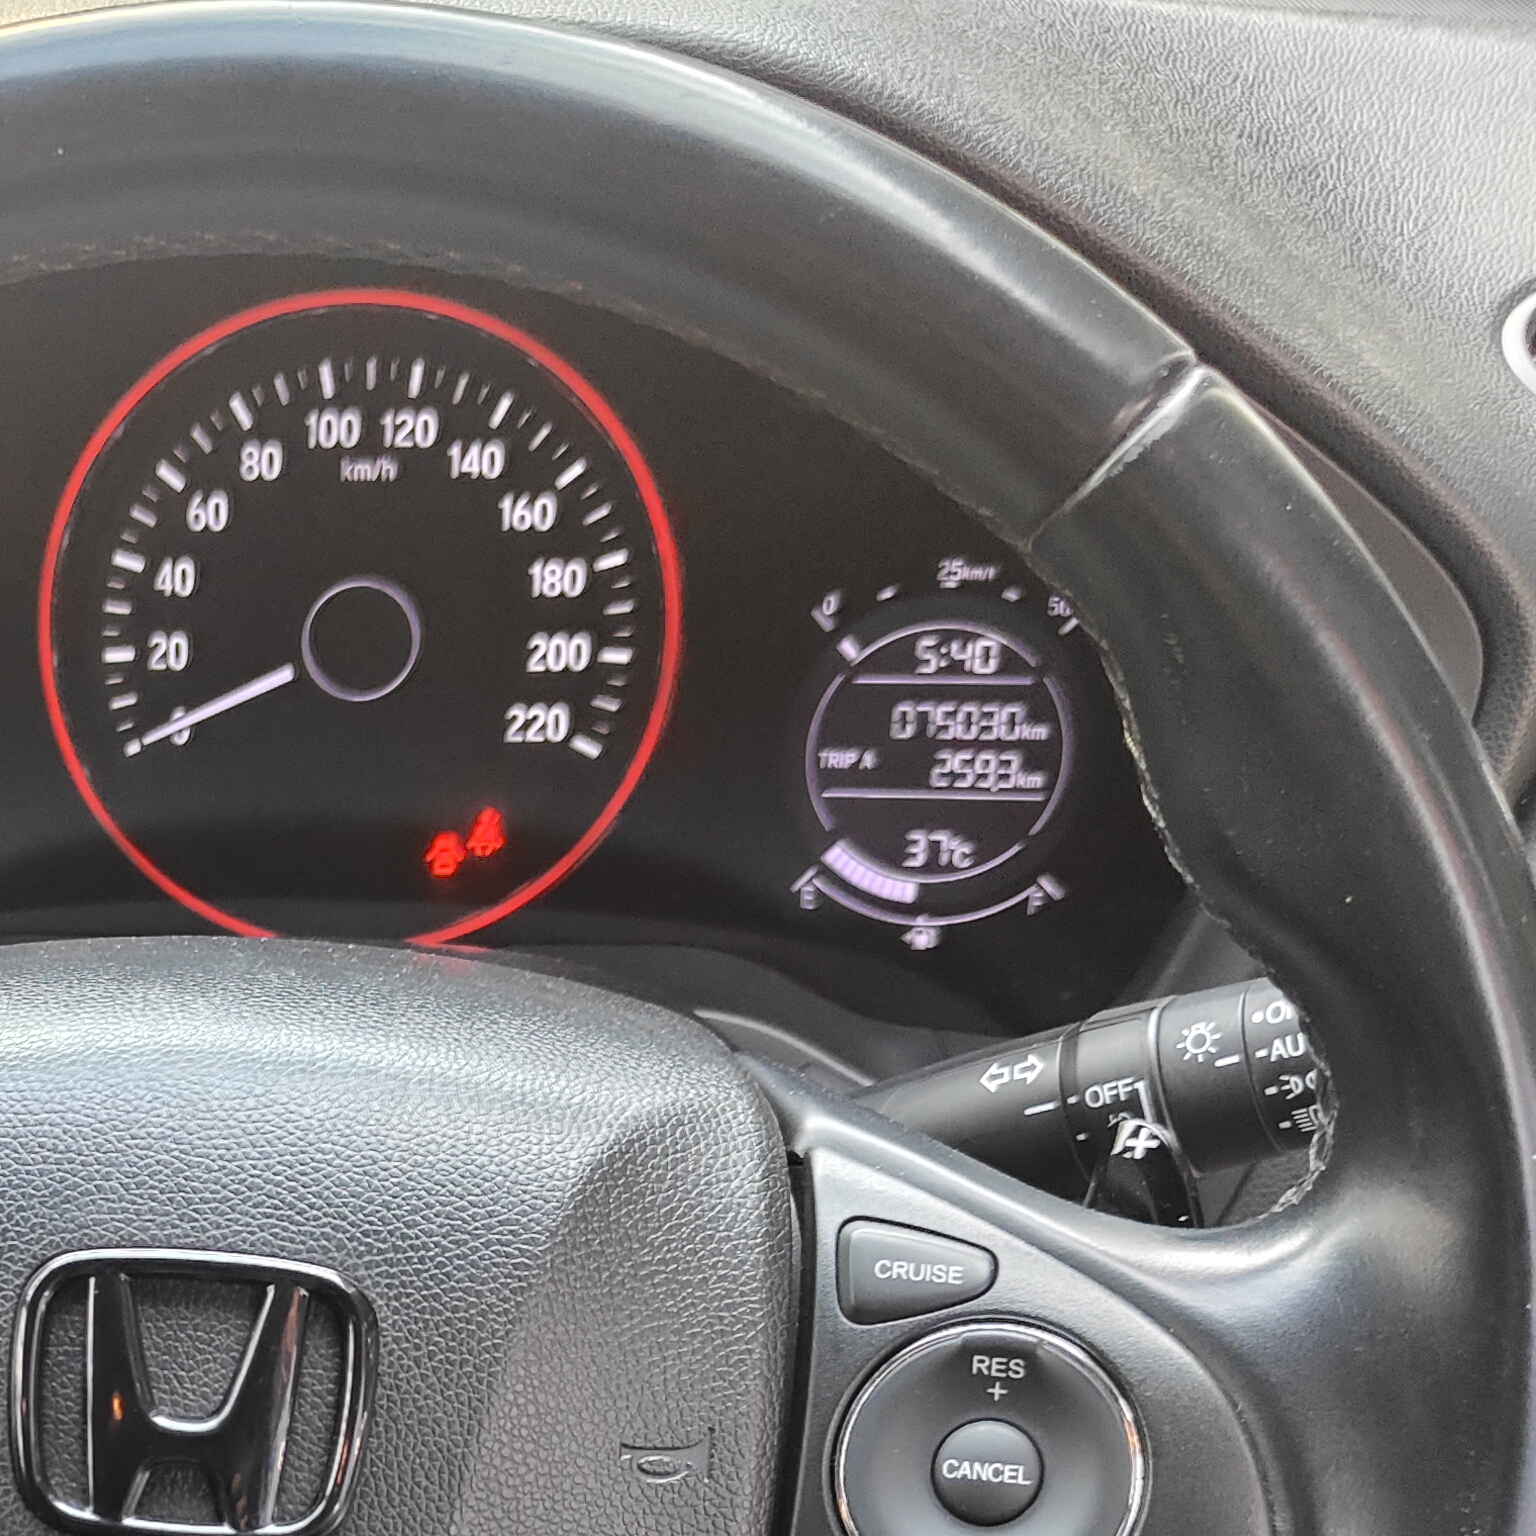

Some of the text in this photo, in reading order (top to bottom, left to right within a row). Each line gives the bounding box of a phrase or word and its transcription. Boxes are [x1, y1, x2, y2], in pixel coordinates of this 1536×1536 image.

[304, 406, 363, 450] 100
[380, 406, 440, 450] 120
[238, 438, 284, 482] 80
[339, 456, 399, 484] km/h
[447, 438, 505, 480] 140
[185, 488, 230, 533] 60
[497, 490, 559, 532] 160
[152, 555, 197, 598] 40
[528, 555, 588, 598] 180
[146, 630, 191, 672] 20
[525, 631, 593, 673] 200
[915, 634, 1000, 676] 5:40
[503, 702, 573, 744] 220
[818, 749, 857, 770] TRIP
[1084, 1076, 1136, 1109] OFF
[874, 1258, 965, 1286] CRUISE
[971, 1354, 1026, 1380] RES
[941, 1458, 1034, 1486] CANCEL
